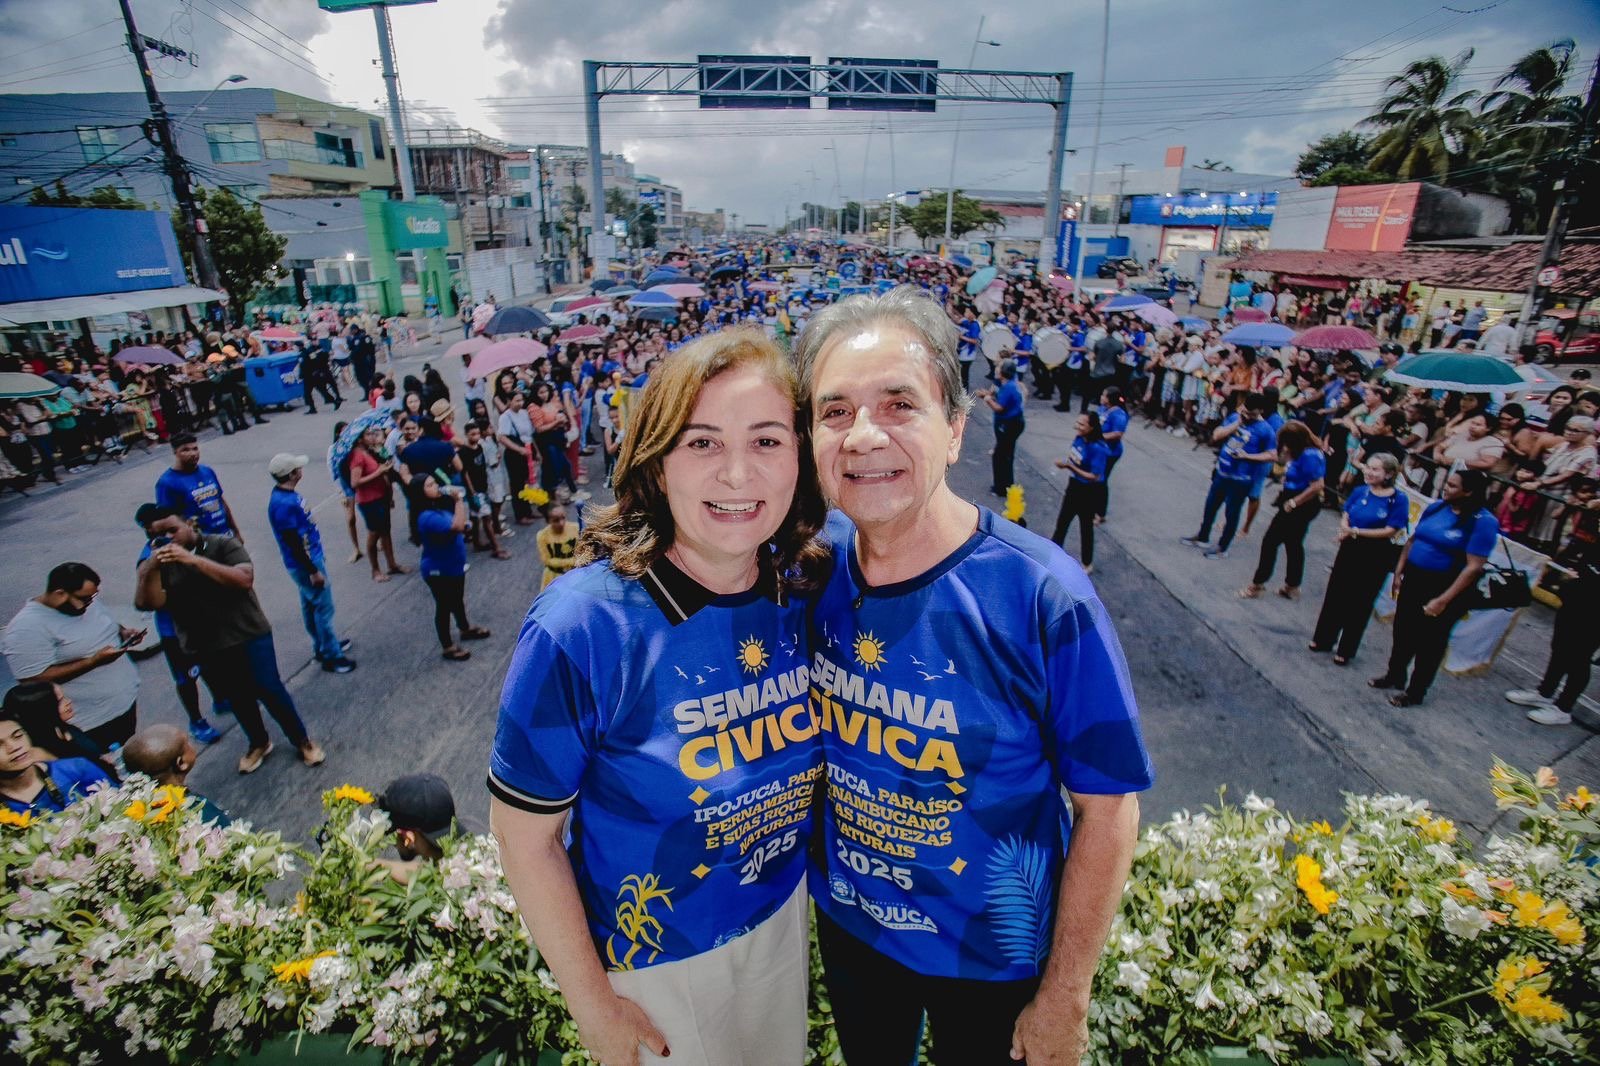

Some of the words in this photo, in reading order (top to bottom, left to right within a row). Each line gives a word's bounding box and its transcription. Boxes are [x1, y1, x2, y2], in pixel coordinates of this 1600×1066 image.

[674, 665, 810, 734] SEMANA
[810, 652, 960, 735] SEMANA
[694, 780, 785, 823] IPOJUCA,
[878, 787, 963, 815] PARAÍSO
[705, 836, 720, 850] E
[723, 816, 761, 846] SUAS
[739, 809, 808, 856] NATURAIS
[837, 819, 916, 859] ATURAIS
[856, 812, 952, 847] RIQUEZAS
[739, 828, 799, 886] 2025
[836, 838, 914, 891] 2025
